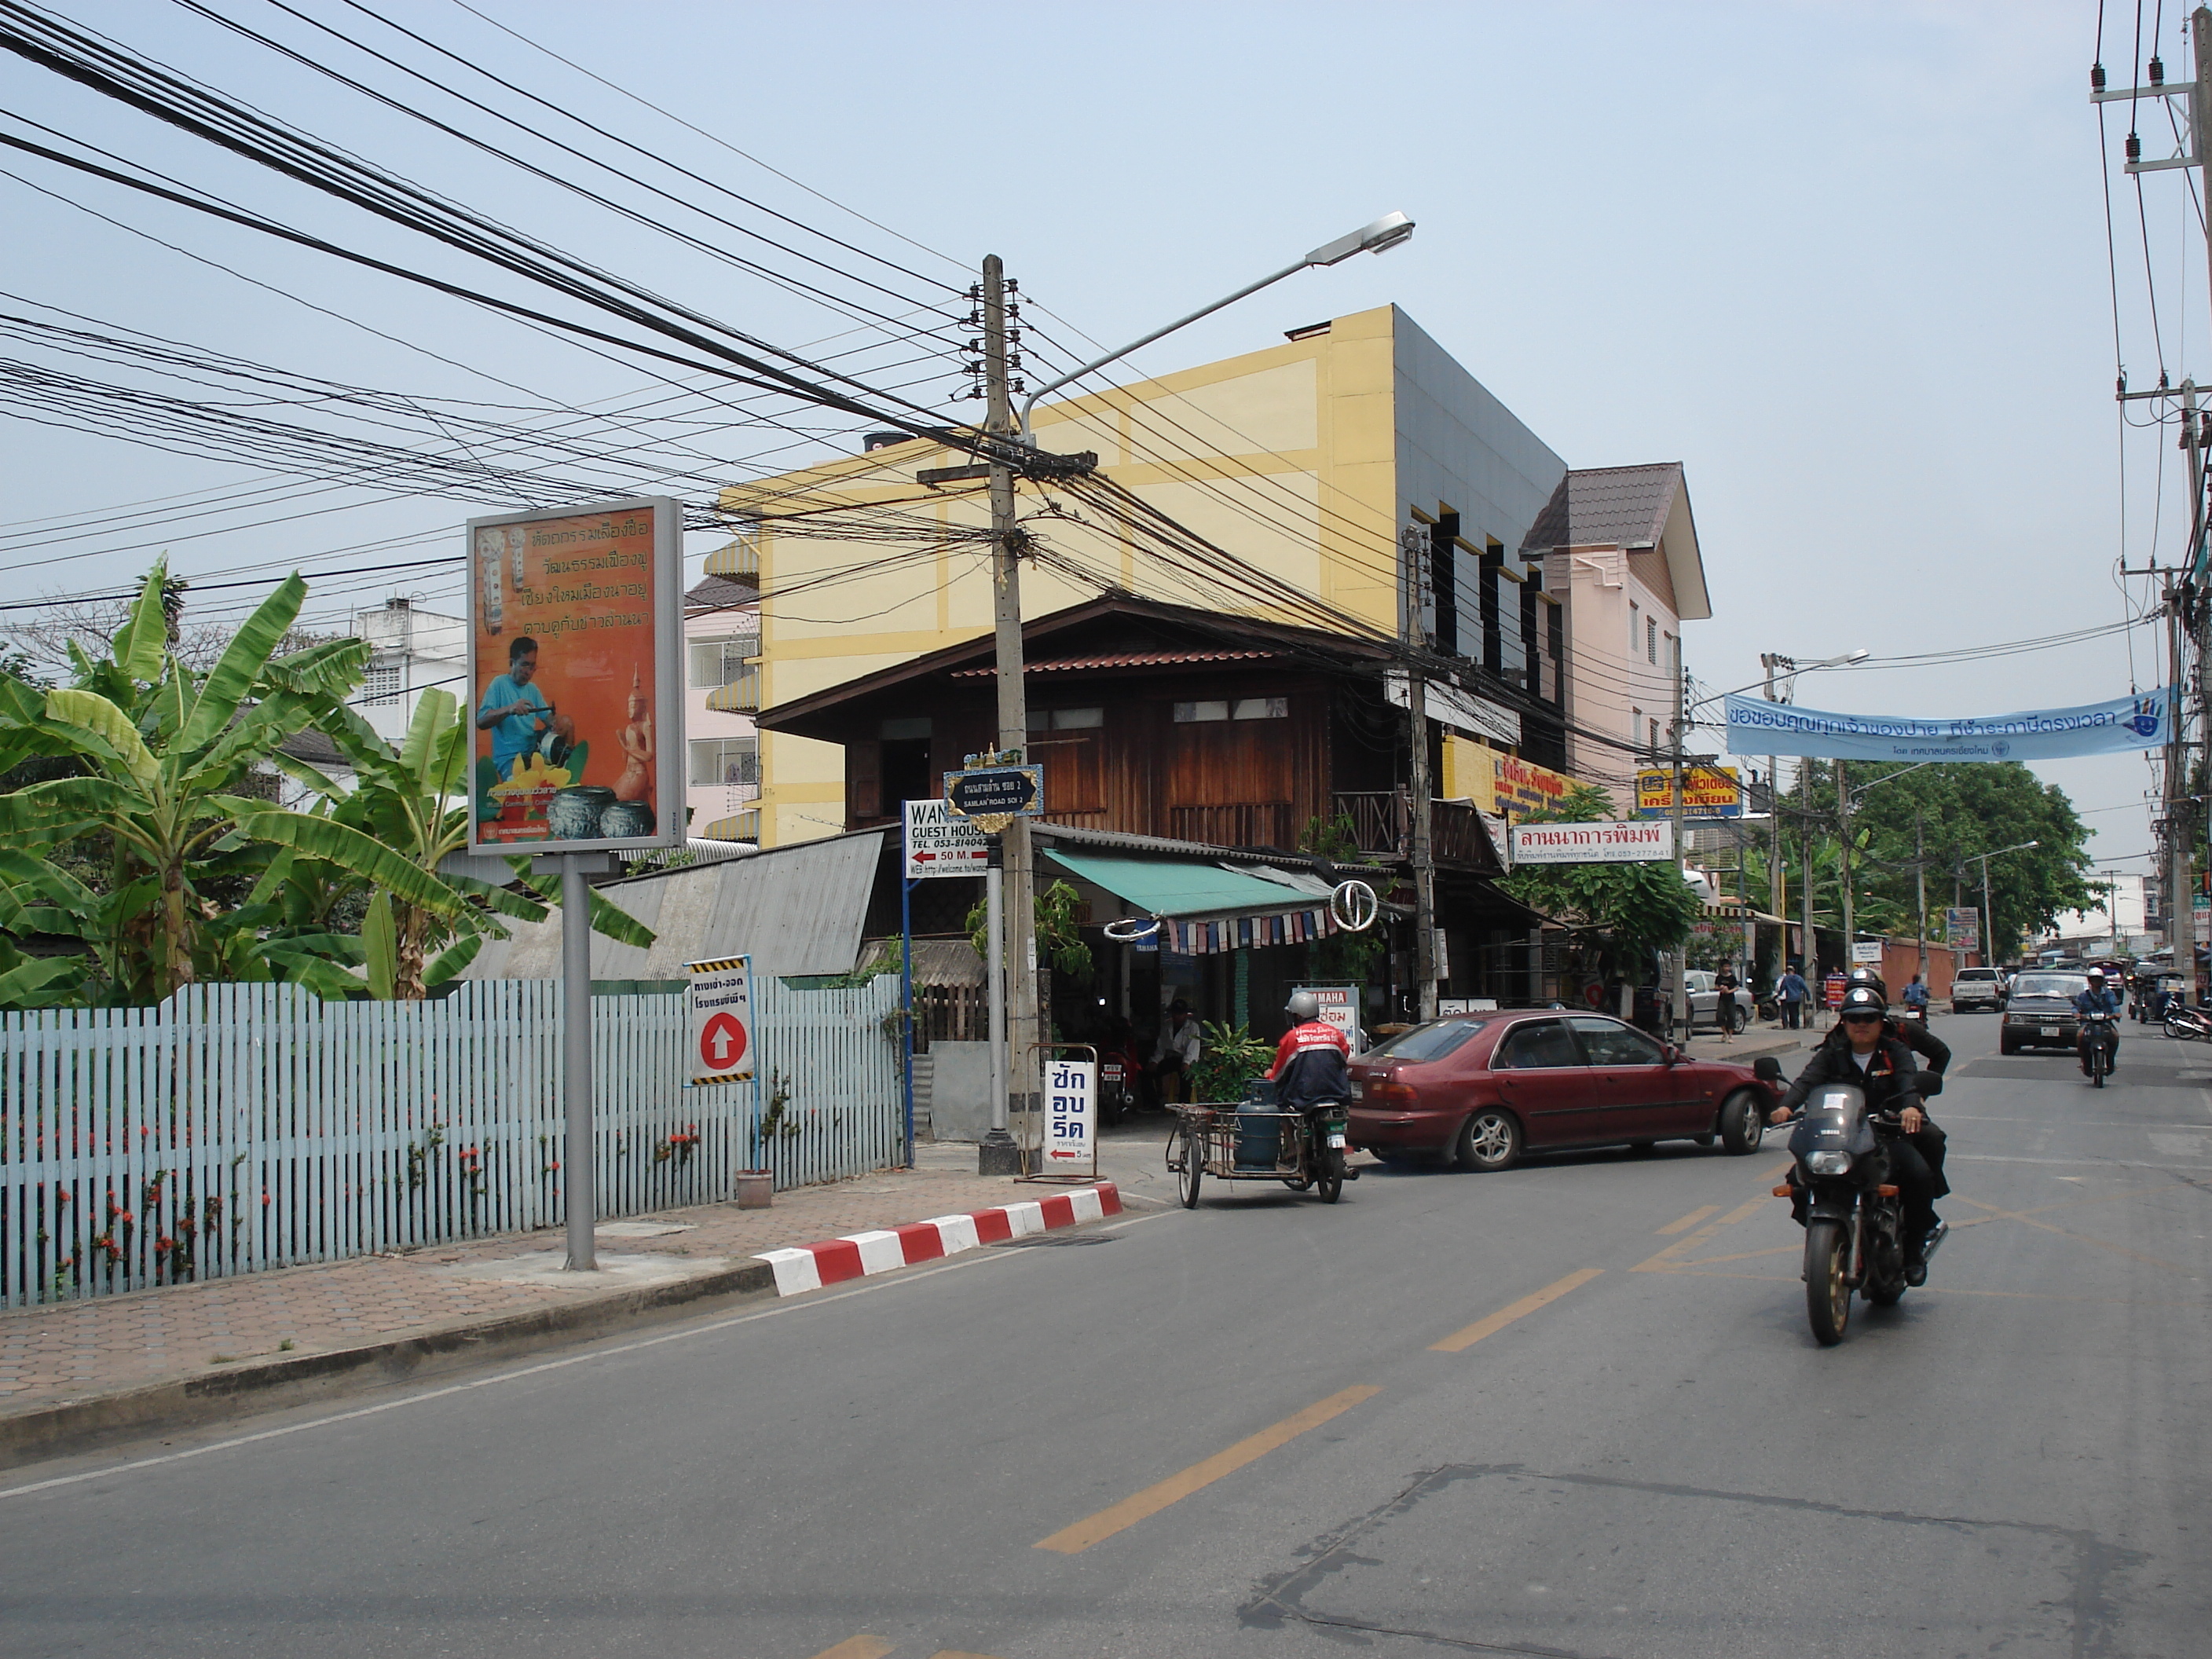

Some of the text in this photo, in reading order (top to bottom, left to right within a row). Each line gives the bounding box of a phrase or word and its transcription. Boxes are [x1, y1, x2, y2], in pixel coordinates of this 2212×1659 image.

[1016, 780, 1021, 790] 2
[989, 797, 1006, 806] ROAD
[1644, 793, 1733, 806] เครื่งเขียน
[912, 826, 947, 838] GUEST
[1521, 823, 1663, 846] ลานนาการพิมพ์
[913, 840, 930, 849] TEL.
[940, 850, 969, 860] 50 M.
[1313, 992, 1345, 1003] AMAHA
[1052, 1064, 1086, 1090] ซัก
[1053, 1096, 1085, 1113] อบ
[1053, 1115, 1084, 1139] รีด
